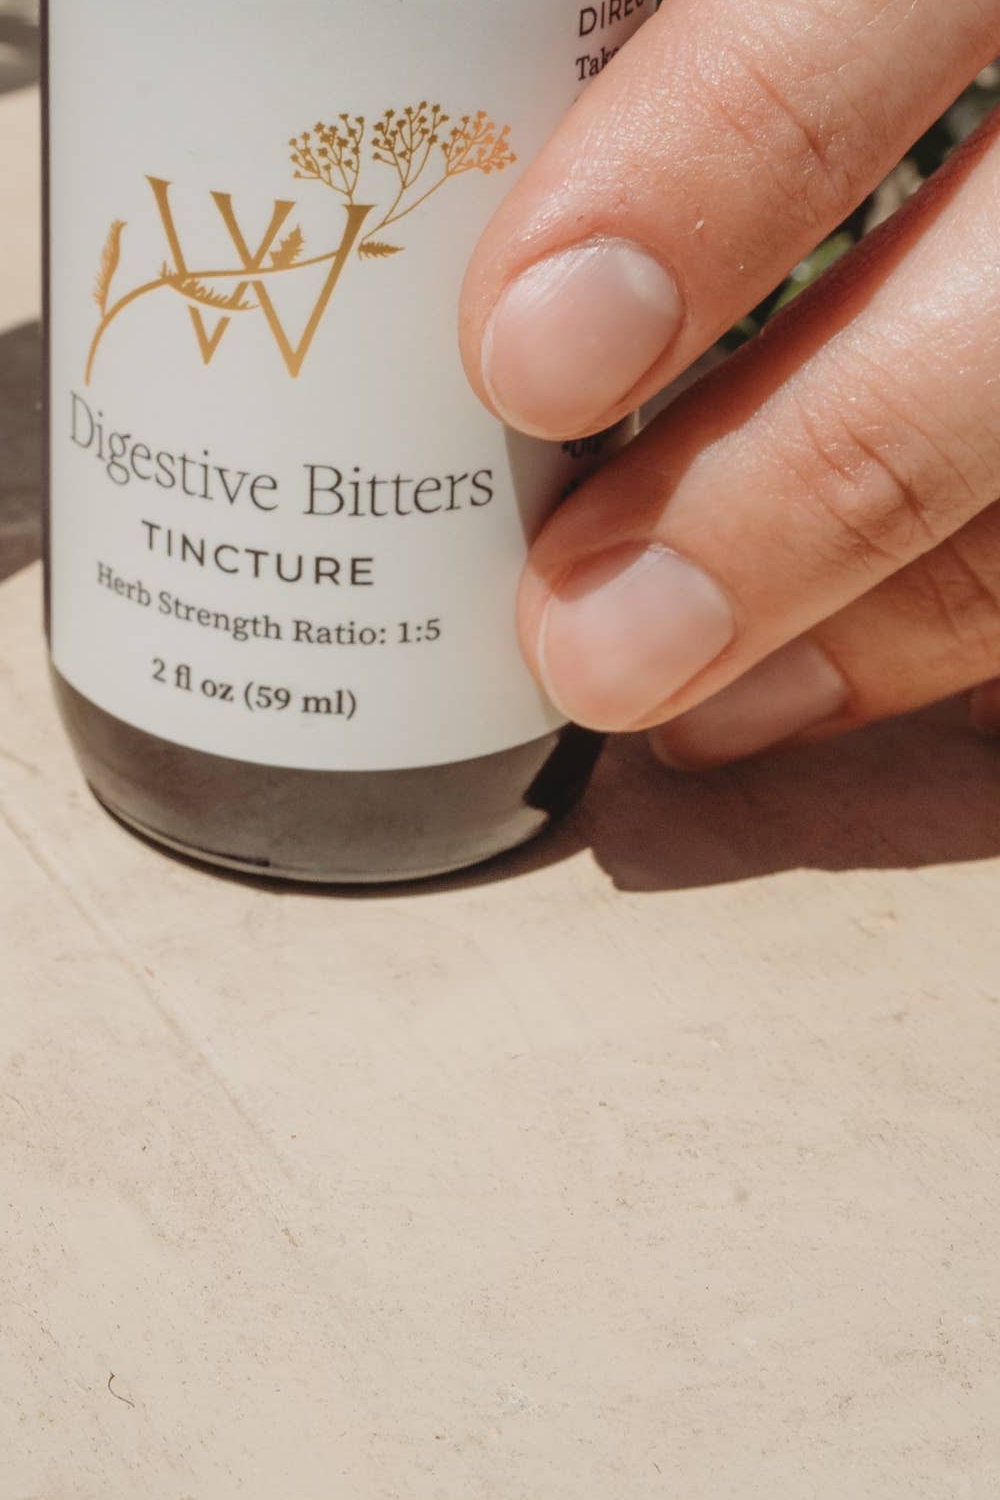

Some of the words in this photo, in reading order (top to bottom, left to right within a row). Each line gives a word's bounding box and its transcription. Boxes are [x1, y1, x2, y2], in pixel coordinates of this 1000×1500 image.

[69, 390, 280, 512] Digestive
[302, 463, 495, 518] Bitters
[140, 519, 376, 586] TINCTURE
[96, 560, 153, 608] Herb
[157, 591, 283, 642] Strength
[292, 619, 387, 646] Ratio:
[397, 617, 442, 645] 1:5
[151, 657, 167, 682] 2
[174, 664, 193, 693] fl
[201, 678, 235, 703] oz
[243, 681, 292, 712] (59
[301, 690, 358, 721] ml)
